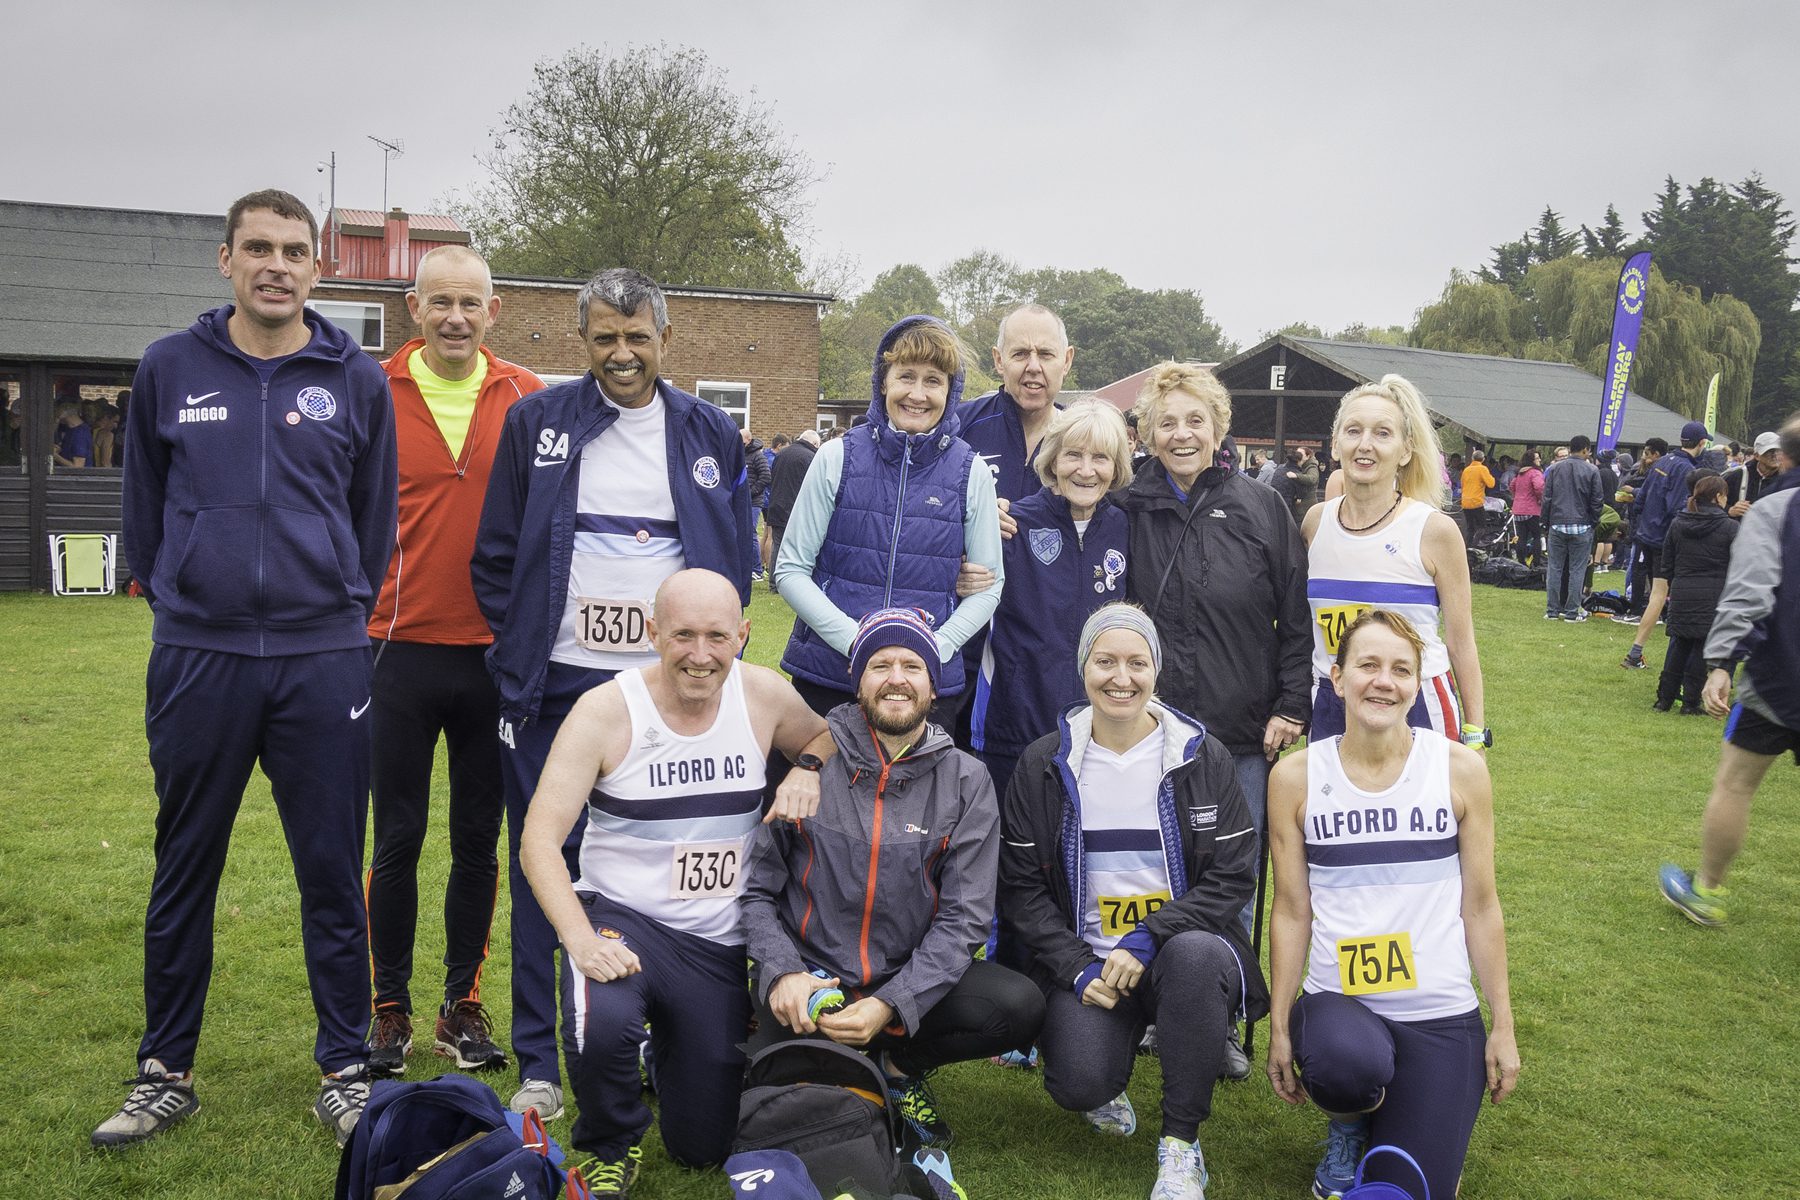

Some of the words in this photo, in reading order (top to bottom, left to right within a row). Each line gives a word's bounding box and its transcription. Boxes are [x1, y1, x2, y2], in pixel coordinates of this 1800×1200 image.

[1604, 341, 1626, 437] BILLERICAY
[1613, 351, 1632, 428] RIDERS
[178, 406, 228, 424] BRIGGO
[537, 428, 569, 459] SA
[1035, 533, 1058, 554] ILFORD
[580, 604, 645, 645] 133D
[1320, 609, 1363, 648] 74
[649, 757, 716, 788] ILFORD
[723, 754, 746, 780] AC
[1313, 807, 1398, 841] ILFORD
[1410, 806, 1448, 833] A.C
[677, 850, 736, 891] 133C
[1340, 940, 1411, 986] 75A
[503, 1181, 525, 1199] adidas
